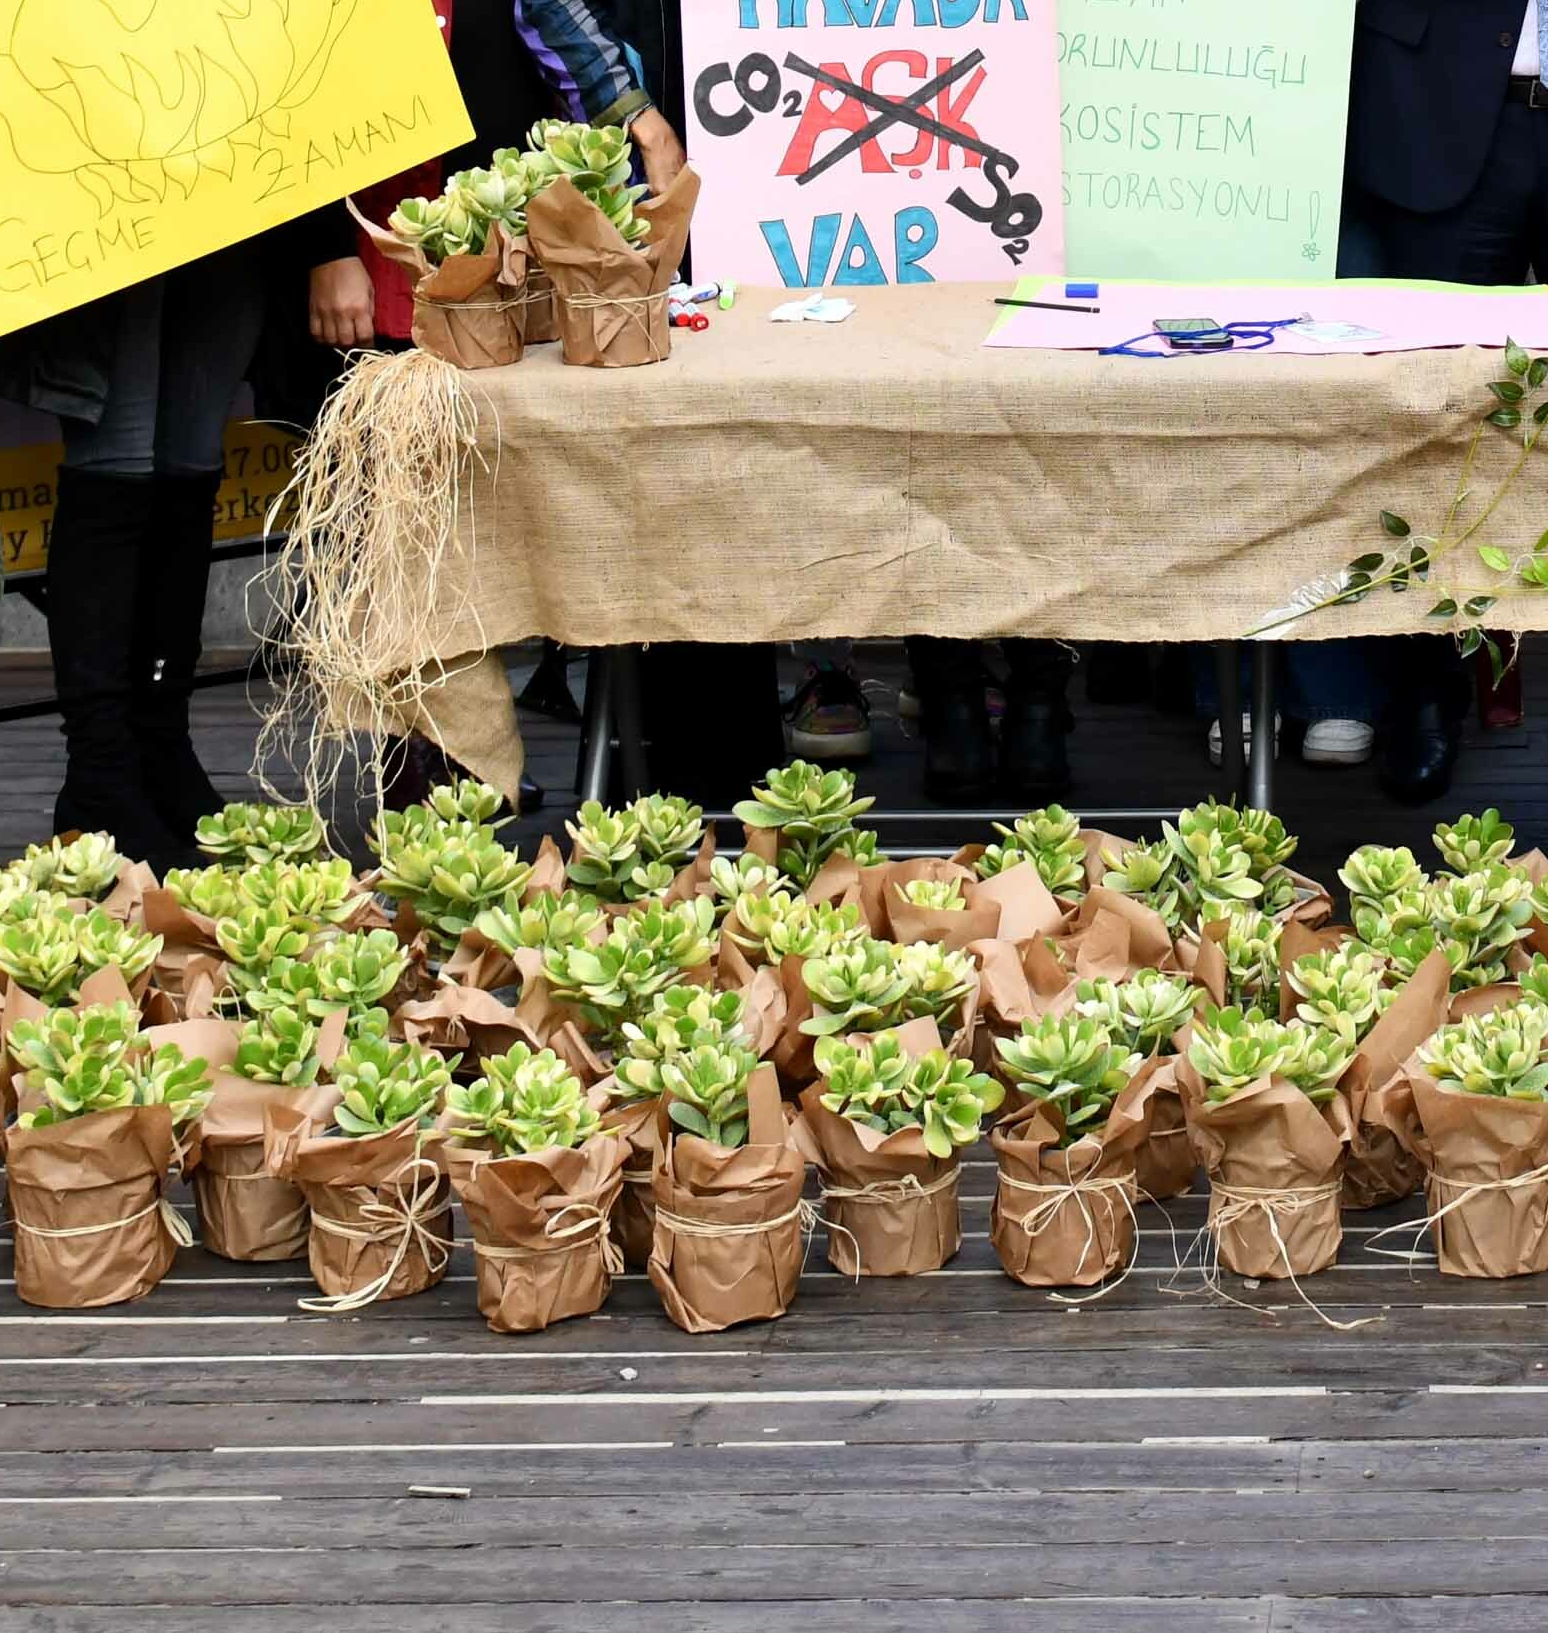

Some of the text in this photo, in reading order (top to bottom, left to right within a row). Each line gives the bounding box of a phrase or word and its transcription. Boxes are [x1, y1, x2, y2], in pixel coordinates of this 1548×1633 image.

[252, 95, 431, 203] ZAMANI
[774, 49, 988, 179] AŞK
[1059, 102, 1255, 157] KOSİSTEM
[1061, 170, 1290, 222] STORASYONU
[759, 206, 938, 288] VAR
